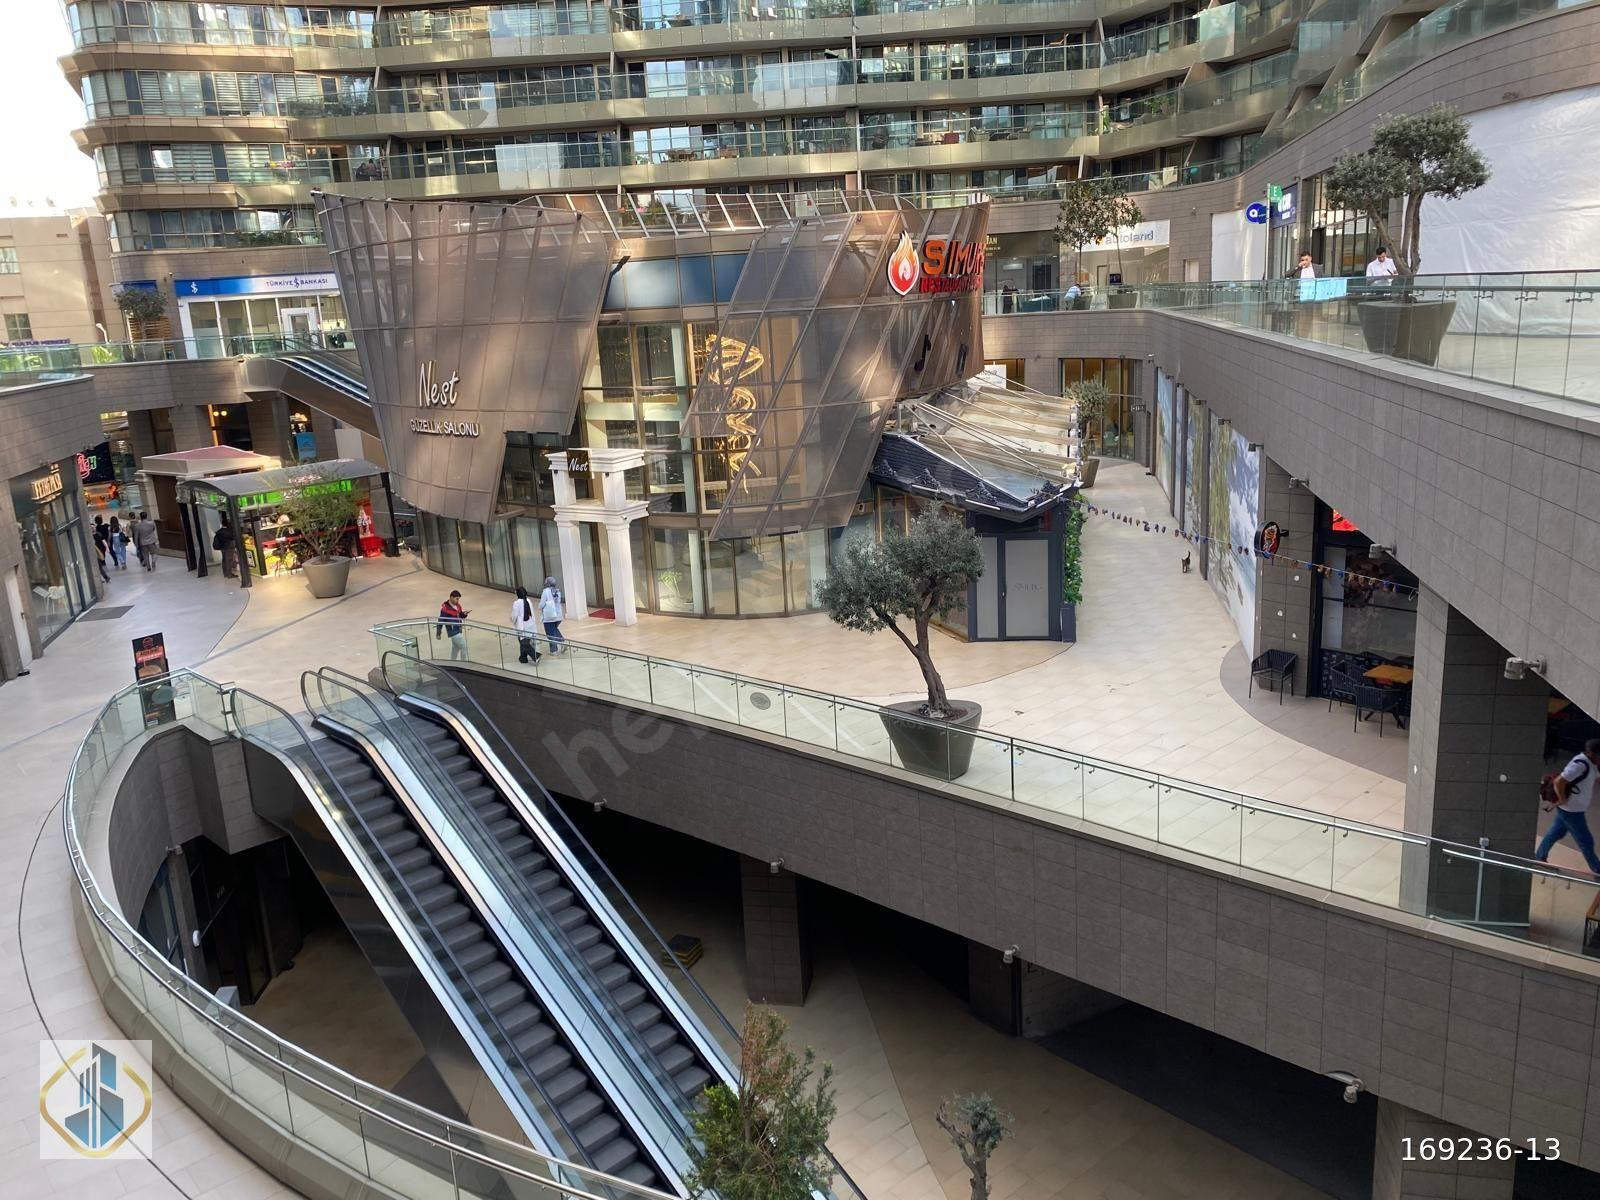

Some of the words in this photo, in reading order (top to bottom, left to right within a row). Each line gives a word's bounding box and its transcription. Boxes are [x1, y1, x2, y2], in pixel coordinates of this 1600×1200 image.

[300, 278, 328, 286] BANKASI
[419, 360, 460, 408] Nest
[443, 420, 479, 437] SALONU
[565, 457, 588, 472] Nest
